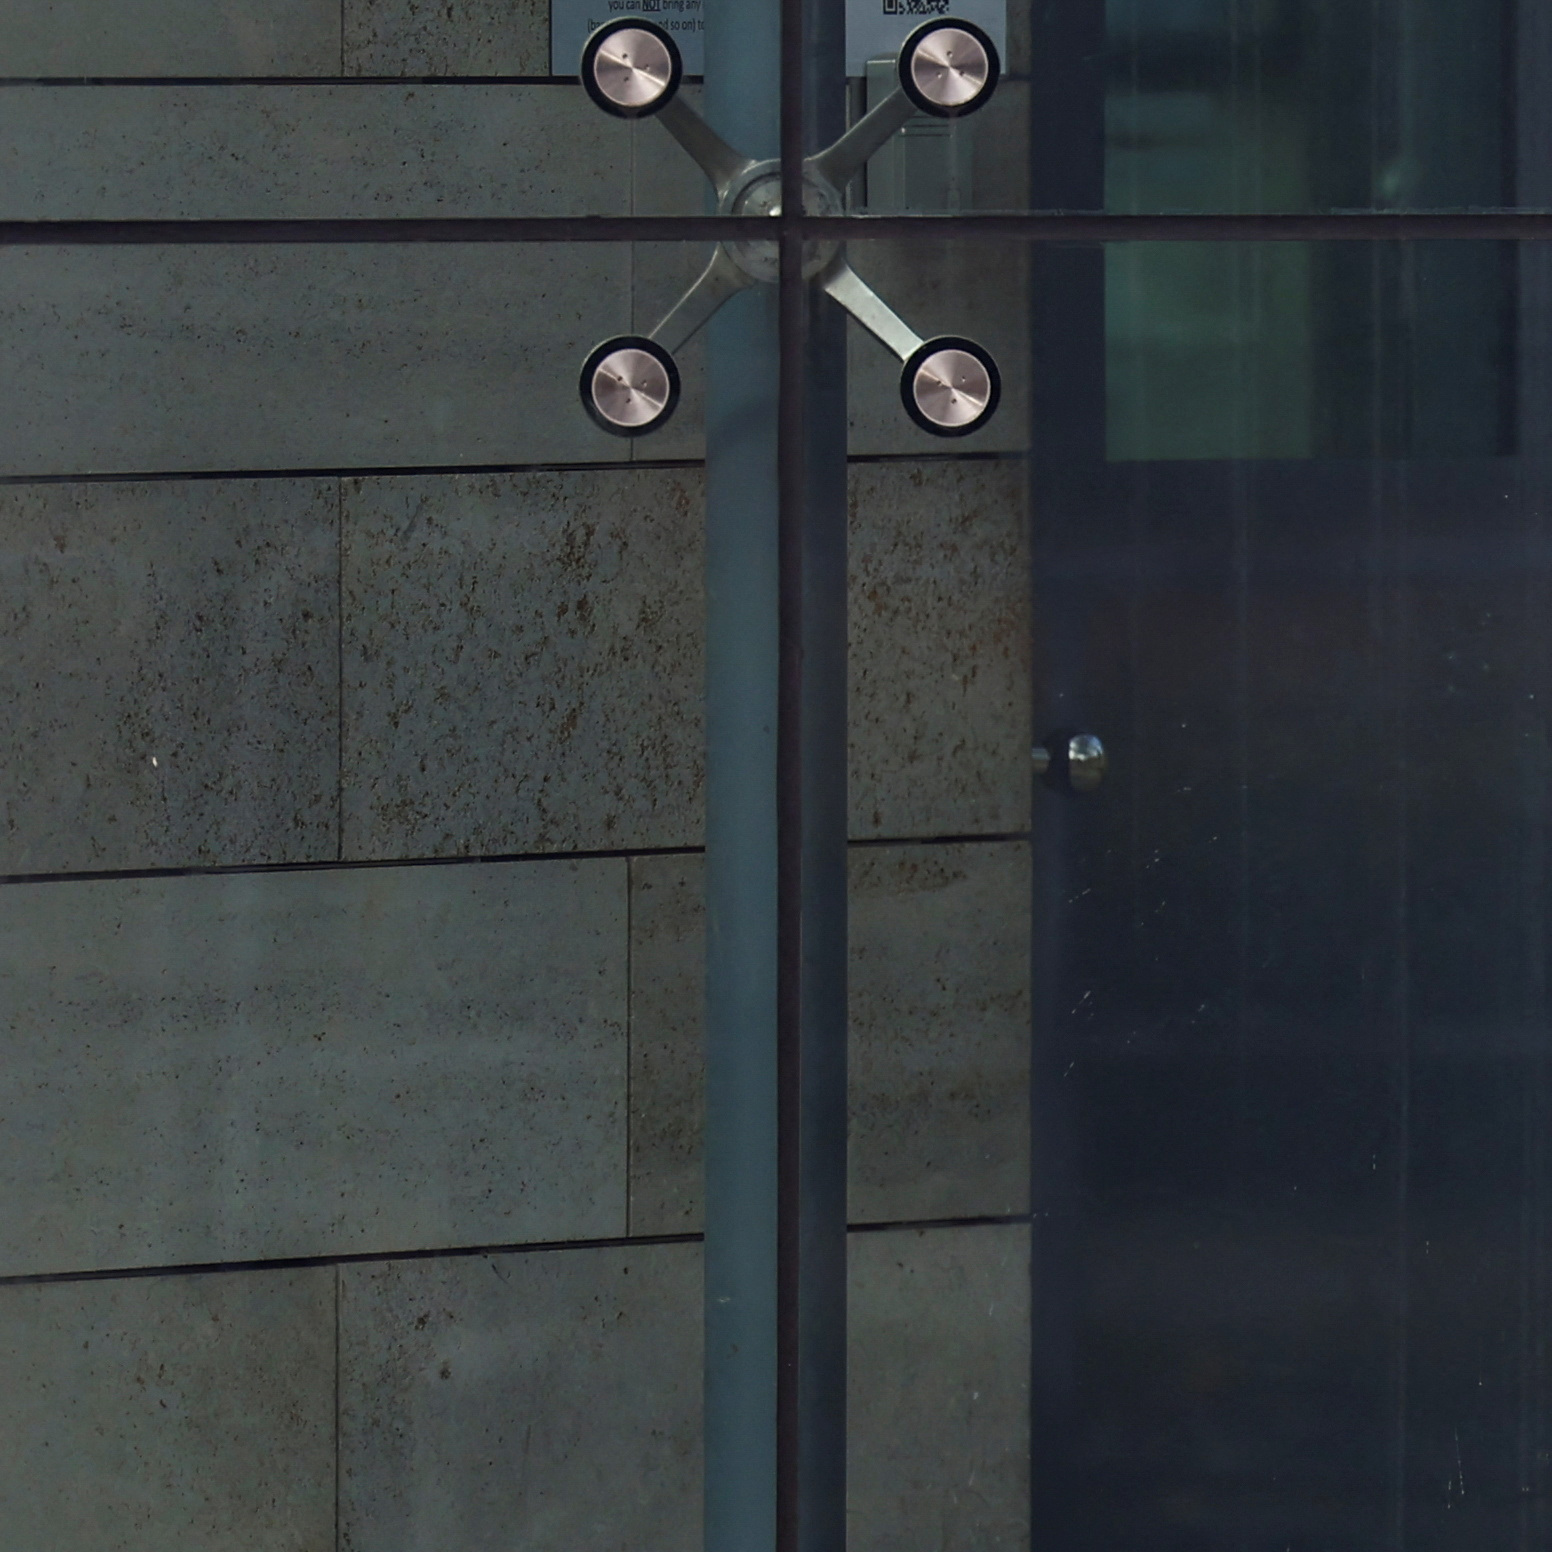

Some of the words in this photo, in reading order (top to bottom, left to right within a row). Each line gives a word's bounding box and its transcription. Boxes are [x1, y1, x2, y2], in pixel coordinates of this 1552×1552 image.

[608, 0, 624, 12] you
[626, 0, 641, 11] can
[686, 0, 701, 12] any
[671, 22, 680, 31] so
[682, 18, 696, 33] on)
